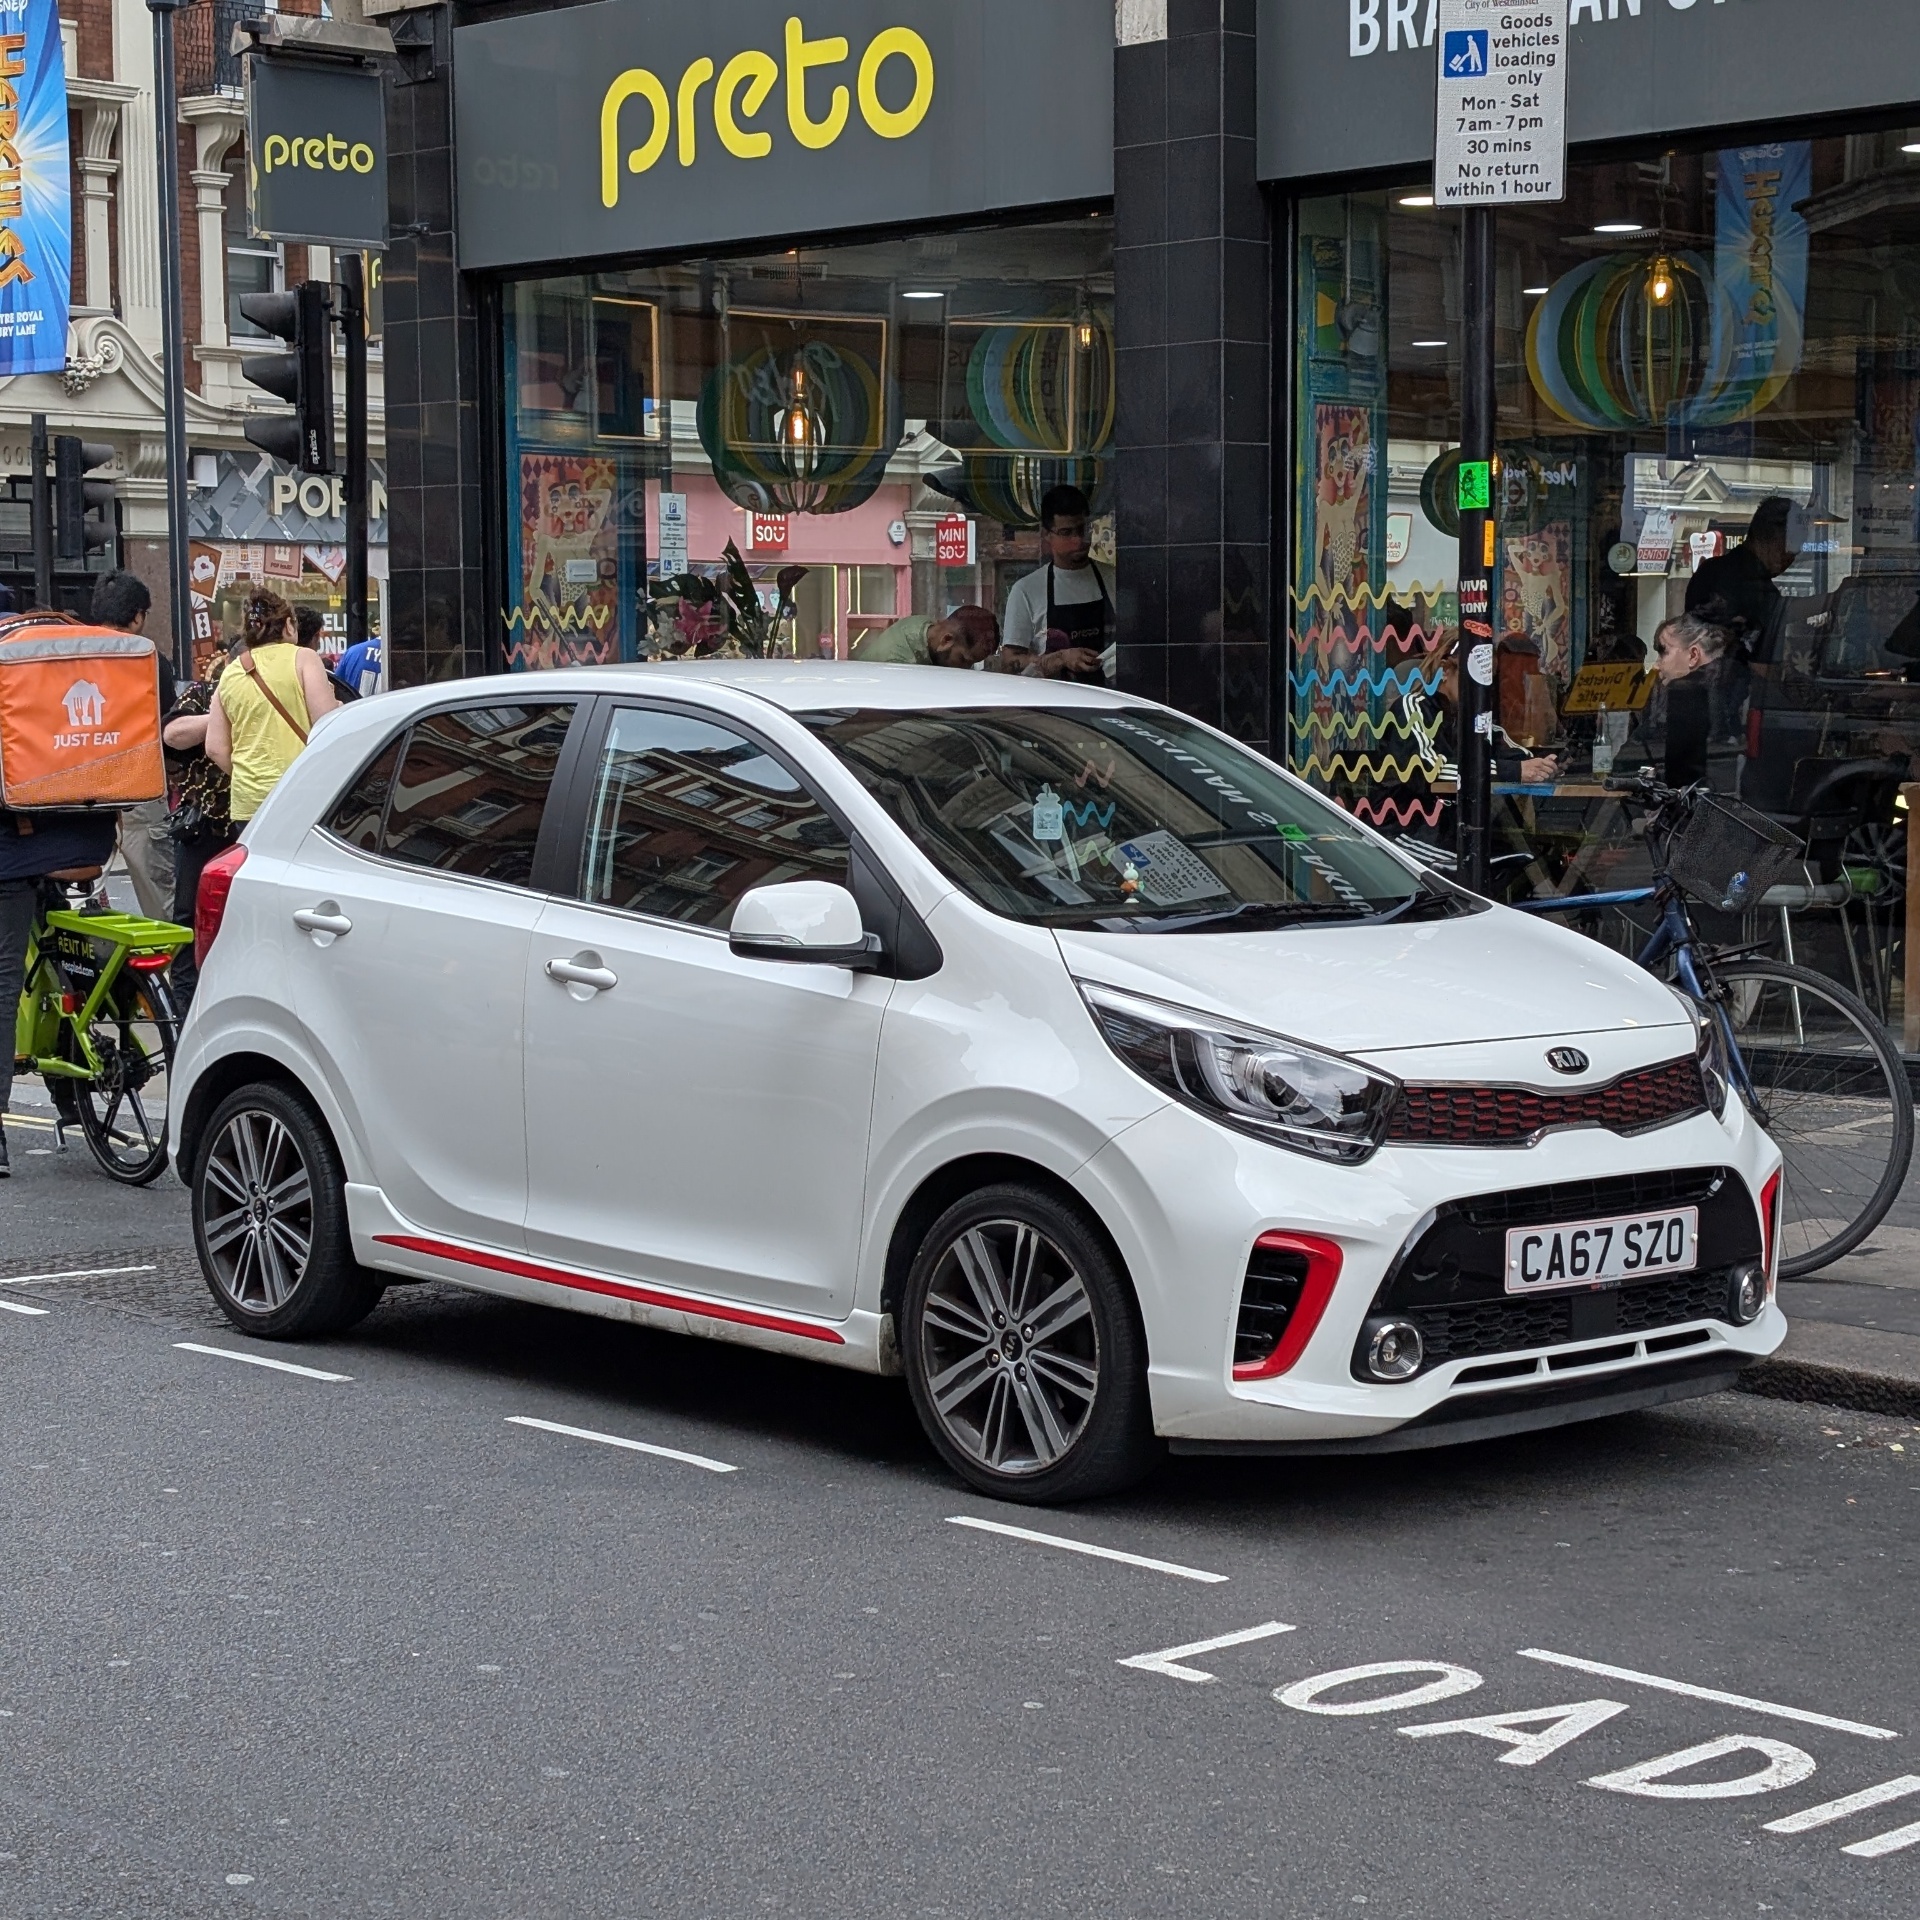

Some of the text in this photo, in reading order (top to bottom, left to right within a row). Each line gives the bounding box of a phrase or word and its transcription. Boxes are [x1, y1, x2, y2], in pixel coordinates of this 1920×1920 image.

[1501, 13, 1553, 30] Goods
[1492, 32, 1560, 49] vehicles
[1495, 51, 1556, 68] loading
[1507, 70, 1543, 87] only
[1462, 96, 1496, 111] Mon
[1510, 93, 1540, 109] Sat
[601, 16, 934, 208] preto
[264, 132, 374, 174] preto
[1467, 138, 1532, 154] 30 mins
[1458, 162, 1539, 178] No return
[1445, 179, 1552, 197] within 1 hour
[16, 309, 45, 323] ROYAL
[16, 324, 37, 336] LANE
[1637, 549, 1669, 560] DENTIST
[1460, 579, 1488, 592] VIVA
[1460, 602, 1488, 614] TONY
[53, 731, 121, 750] JUST EAT
[81, 941, 96, 960] ME
[1551, 1050, 1587, 1068] KIA
[1520, 1217, 1684, 1283] CA67 SZO
[1004, 1335, 1017, 1360] KIA
